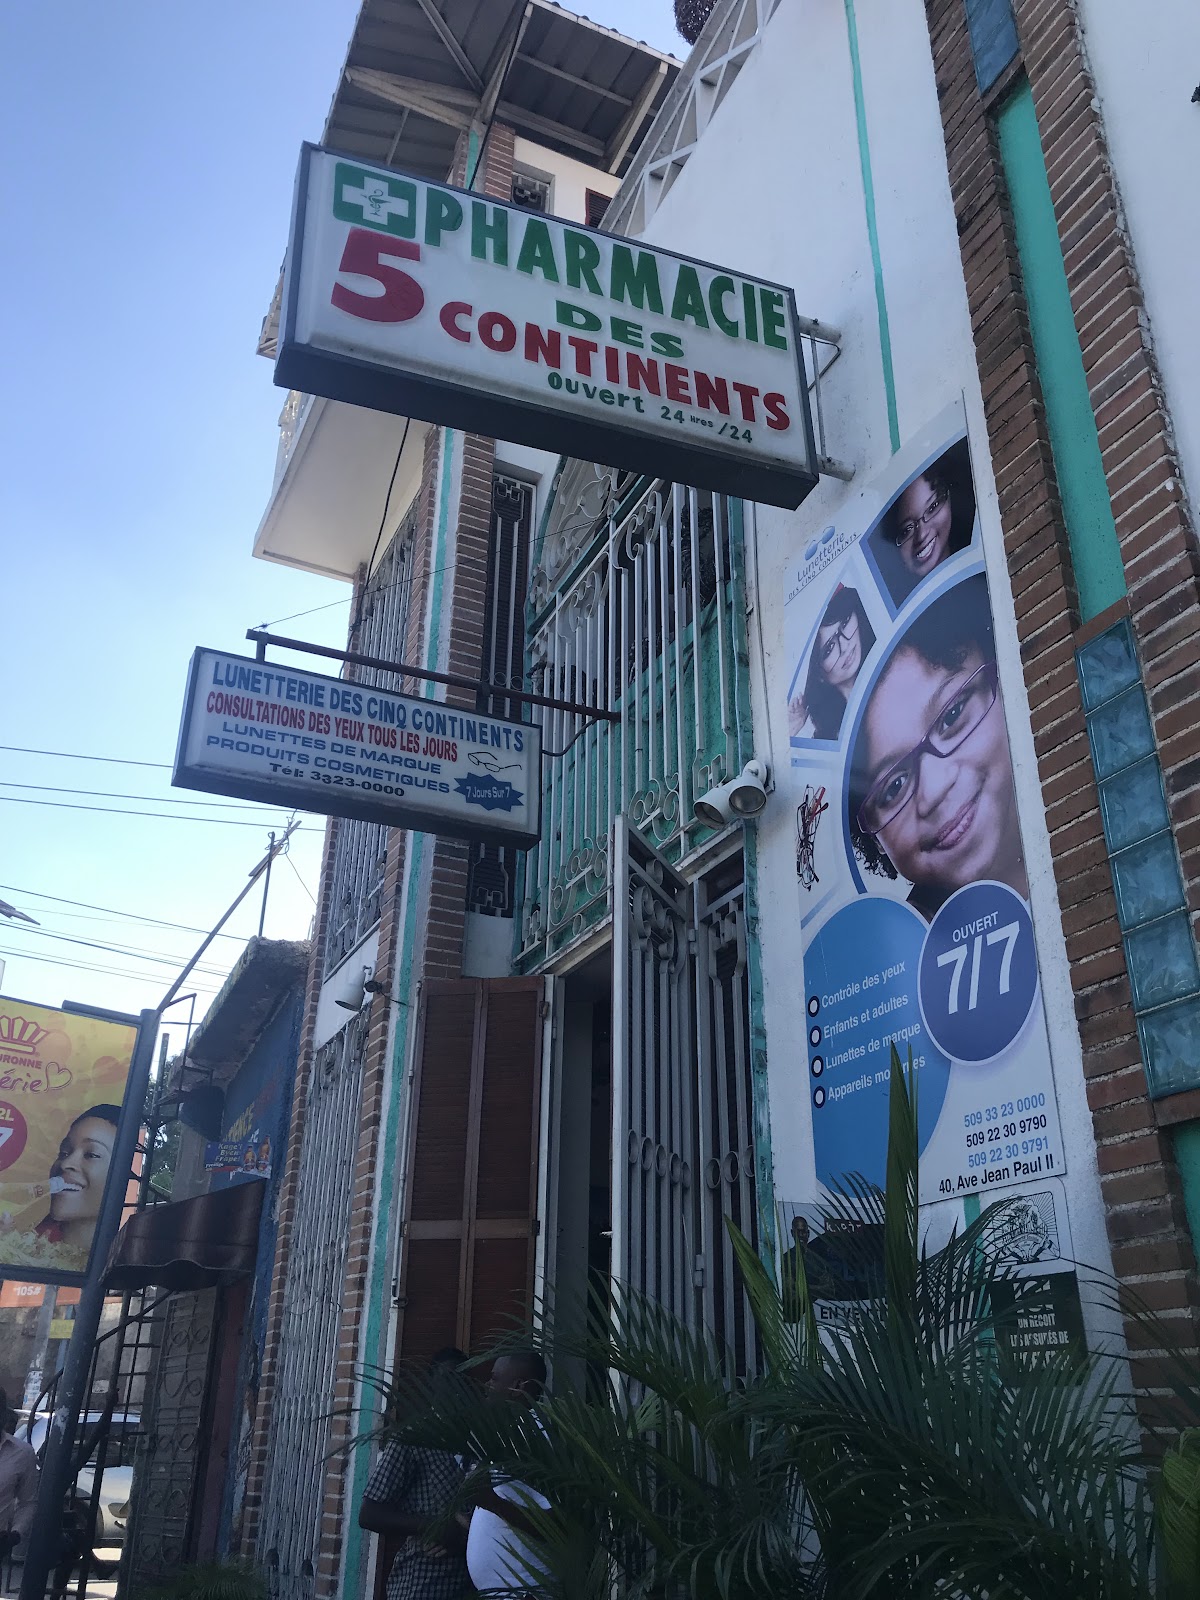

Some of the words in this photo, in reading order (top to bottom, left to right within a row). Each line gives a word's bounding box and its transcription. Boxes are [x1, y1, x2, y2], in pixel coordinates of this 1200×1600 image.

[425, 187, 789, 351] PHARMACIE
[330, 227, 426, 323] 5
[438, 301, 791, 432] CONTINENTS
[554, 300, 685, 358] DES
[547, 371, 646, 414] Ouvert
[660, 405, 686, 424] 24
[718, 421, 754, 444] /24
[788, 587, 800, 600] DES
[818, 531, 857, 571] CONTINENTS
[797, 532, 844, 582] Lunetterie
[206, 691, 305, 730] CONSULTATIONS
[308, 714, 330, 736] DES
[334, 717, 364, 743] YEUX
[368, 724, 397, 749] TOUS
[400, 731, 420, 753] LES
[422, 737, 458, 762] JOURS
[212, 661, 325, 708] LUNETTERIE
[330, 689, 363, 717] DES
[367, 699, 407, 729] CINQ
[412, 709, 524, 752] CONTINENTS
[206, 736, 310, 765] PRODUITS
[315, 757, 450, 794] COSMETIQUES
[222, 722, 327, 751] LUNETTES
[331, 742, 357, 758] DE
[360, 748, 441, 775] MARQUE
[311, 771, 405, 798] 3323-0000
[466, 785, 472, 798] 7
[472, 786, 492, 799] Jours
[492, 786, 505, 799] Sur
[505, 786, 510, 798] 7
[952, 911, 999, 943] OUVERT
[821, 983, 860, 1009] Contrôle
[862, 973, 880, 989] des
[882, 961, 906, 984] yeux
[937, 920, 1020, 1015] 7/7
[823, 1015, 859, 1039] Enfants
[860, 1008, 871, 1023] et
[872, 994, 909, 1019] adultes
[825, 1045, 866, 1069] Lunettes
[867, 1039, 880, 1053] de
[882, 1023, 921, 1047] marque
[828, 1072, 873, 1101] Appareils
[874, 1055, 926, 1084] mores
[964, 1111, 983, 1128] 509
[985, 1106, 999, 1122] 33
[1000, 1101, 1014, 1117] 23
[1016, 1092, 1046, 1113] 0000
[966, 1131, 985, 1148] 509
[987, 1127, 1001, 1142] 22
[1002, 1122, 1017, 1138] 30
[1019, 1114, 1047, 1134] 9790
[939, 1178, 955, 1194] 40,
[957, 1174, 978, 1190] Ave
[980, 1167, 1010, 1185] Jean
[1013, 1156, 1042, 1177] Paul
[1045, 1153, 1054, 1170] II
[968, 1151, 987, 1168] 509
[989, 1147, 1003, 1163] 22
[1005, 1143, 1019, 1159] 30
[1021, 1135, 1049, 1155] 9791
[1058, 1330, 1070, 1344] DE
